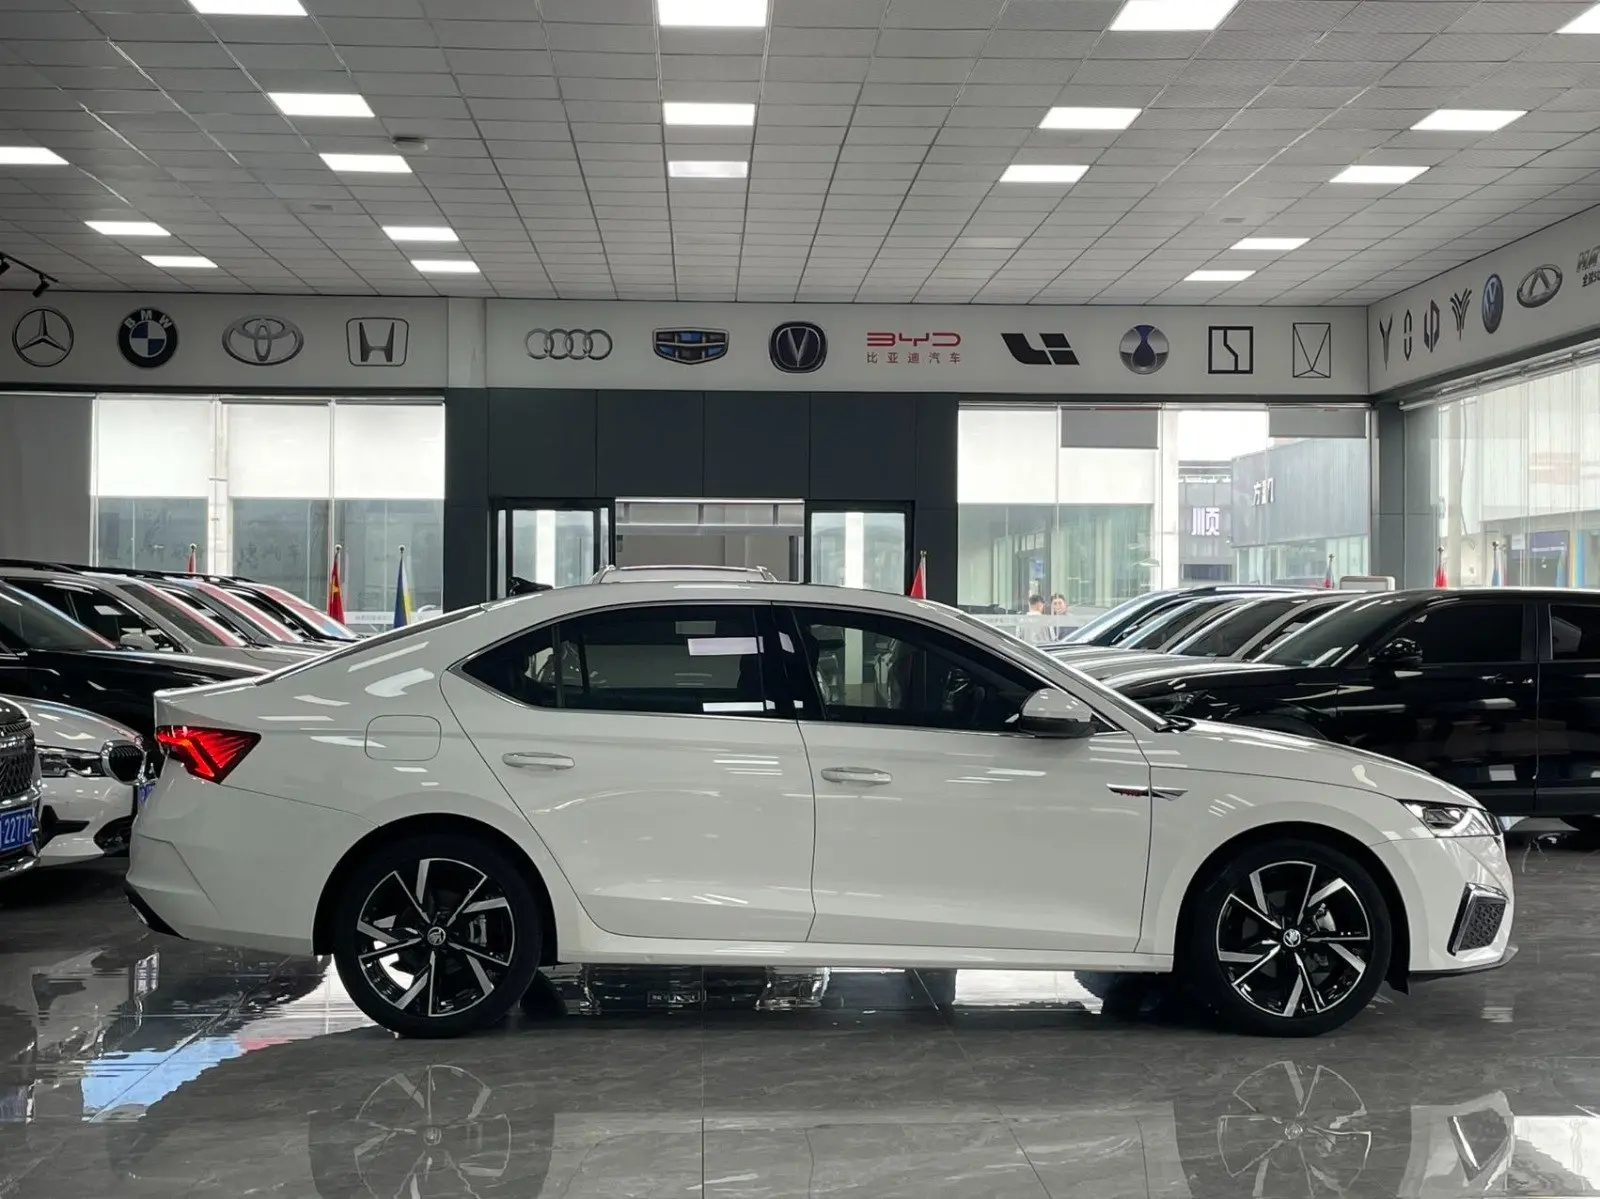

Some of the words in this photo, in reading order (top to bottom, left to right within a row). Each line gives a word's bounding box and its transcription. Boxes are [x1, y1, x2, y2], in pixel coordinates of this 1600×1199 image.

[123, 309, 173, 329] BMW
[867, 332, 961, 347] BYD
[866, 352, 961, 364] 比亚迪汽车
[1191, 507, 1220, 536] 顺
